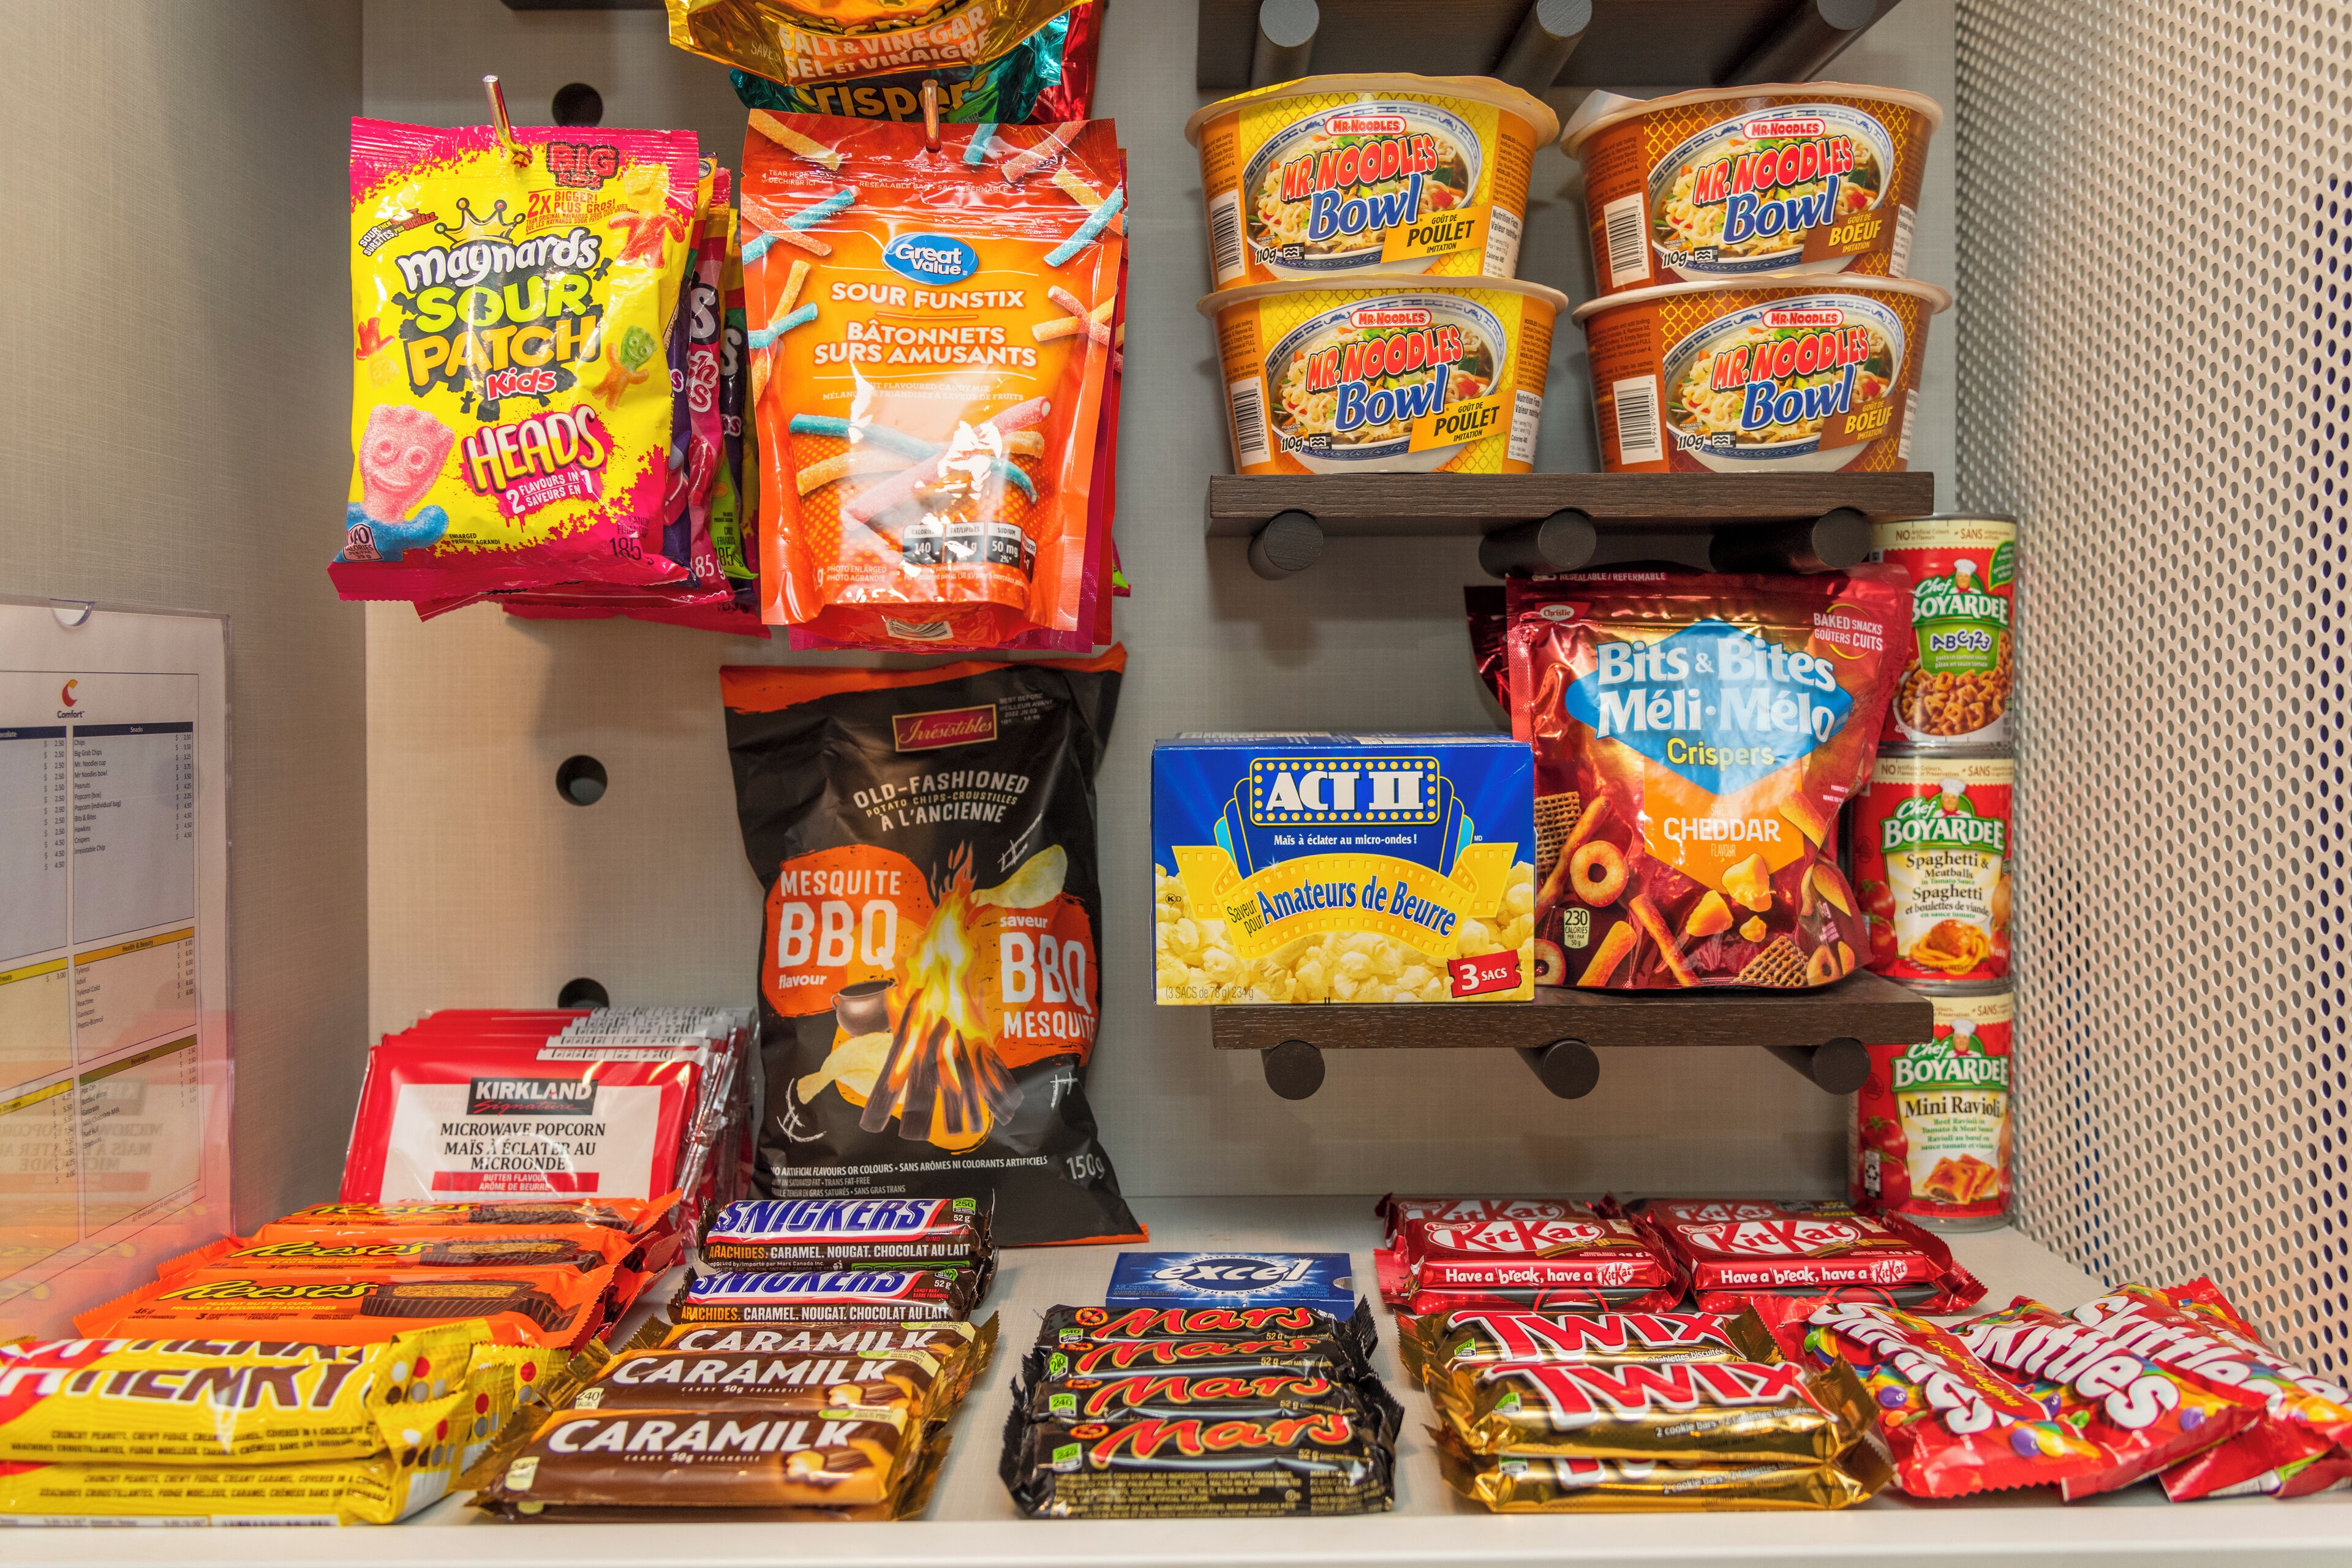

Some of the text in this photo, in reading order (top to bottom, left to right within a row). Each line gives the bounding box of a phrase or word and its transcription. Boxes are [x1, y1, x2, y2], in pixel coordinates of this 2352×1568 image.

[778, 6, 987, 61] SALT & VINEGAR
[786, 31, 991, 78] SEL ET VINAIGRE
[548, 143, 619, 179] BIG
[1317, 134, 1438, 192] NOODLES
[529, 191, 598, 216] 2X BIGGER!
[554, 199, 616, 213] PLUS GROS!
[1308, 173, 1423, 242] Bowl
[1722, 176, 1838, 245] Bowl
[1432, 215, 1448, 224] GOÛT
[1408, 220, 1475, 247] POULET
[1830, 220, 1882, 246] BOEUF
[398, 229, 598, 289] maynards
[895, 243, 963, 263] Great
[1255, 246, 1276, 266] 110g
[1427, 243, 1457, 254] IMITATION
[911, 258, 962, 276] Value
[417, 275, 591, 333] SOUR
[831, 282, 1025, 309] SOUR FUNSTIX
[847, 320, 1006, 345] BÂTONNETS
[407, 316, 597, 388] PATCH
[813, 342, 1038, 368] SURS AMUSANTS
[1751, 325, 1870, 383] NOODLES
[487, 369, 556, 401] Kids
[1741, 364, 1856, 429] Bowl
[1335, 364, 1448, 432] Bowl
[1434, 406, 1500, 437] POULET
[1844, 405, 1894, 435] BOEUF
[1858, 428, 1882, 440] IMITATION
[464, 404, 606, 493] HEADS
[519, 475, 566, 497] FLAVOURS
[567, 472, 579, 484] IN
[525, 484, 581, 507] SAVEURS EN
[506, 489, 525, 514] 2
[1543, 607, 1572, 618] Christie
[1813, 612, 1883, 635] BAKED SNACKS
[1814, 626, 1883, 651] GOÛTERS CUITS
[1597, 637, 1837, 692] Bits & Bites
[1667, 737, 1775, 772] Crispers
[853, 770, 1030, 810] OLD-FASHIONED
[1266, 771, 1424, 811] ACT II
[866, 790, 1017, 818] POTATO CHIPS-CROUSTILLES
[1897, 799, 1937, 819] Chef
[881, 802, 1008, 832] À L'ANCIENNE
[1663, 817, 1782, 842] CHEDDAR
[1274, 835, 1295, 845] Maïs
[1298, 835, 1305, 845] à
[1307, 834, 1337, 845] éclater
[1340, 837, 1352, 845] au
[1355, 835, 1411, 845] micro-ondes
[1884, 818, 2004, 851] BOYARDEE
[1711, 843, 1736, 858] FLAVOUR
[1906, 851, 1989, 870] Spaghetti &
[780, 869, 902, 897] MESQUITE
[1924, 869, 1973, 879] Meatballs
[1912, 884, 1983, 902] Spaghetti
[1227, 875, 1457, 938] Saveur pour Amateurs de Beurre
[1565, 909, 1588, 926] 230
[1905, 905, 1913, 914] et
[1915, 902, 1953, 913] boulettes
[1967, 904, 1989, 916] viande
[1000, 915, 1048, 929] saveur
[1564, 925, 1588, 935] CALORIES
[778, 900, 899, 973] BBQ
[76, 966, 90, 975] Tylenol
[778, 973, 827, 990] flavour
[1000, 932, 1092, 1014] BBQ
[1460, 964, 1507, 990] 3 SACS
[1003, 1010, 1096, 1039] MESQUITE
[131, 1055, 150, 1065] Beverages
[1894, 1056, 2008, 1087] BOYARDEE
[476, 1081, 593, 1101] KIRKLAND
[83, 1105, 99, 1115] Gatorade
[473, 1099, 589, 1117] Signature
[1905, 1096, 2002, 1118] Mini Ravioli
[440, 1122, 606, 1136] MICROWAVE POPCORN
[444, 1139, 597, 1156] MAÏS À ÉCLATER AU
[470, 1156, 566, 1171] MICROONDE
[899, 1155, 1047, 1172] SANS ARÔMES NI COLORANTS ARTIFICIELS
[1066, 1152, 1105, 1181] 150g
[718, 1199, 935, 1234] SNICKERS
[1452, 1220, 1599, 1252] KitKat
[1154, 1257, 1316, 1281] excel
[1446, 1262, 1634, 1286] Have a break, have a KitKat
[156, 1281, 379, 1300] Reese's
[681, 1306, 949, 1321] ARACHIDES. CARAMEL. NOUGAT. CHOCOLAT AU LAIT
[1090, 1307, 1315, 1341] Mars
[1448, 1311, 1747, 1362] TWIX
[1052, 1397, 1072, 1407] 240
[1482, 1361, 1838, 1430] TWIX
[548, 1419, 862, 1453] CARAMILK
[1089, 1414, 1354, 1468] Mars
